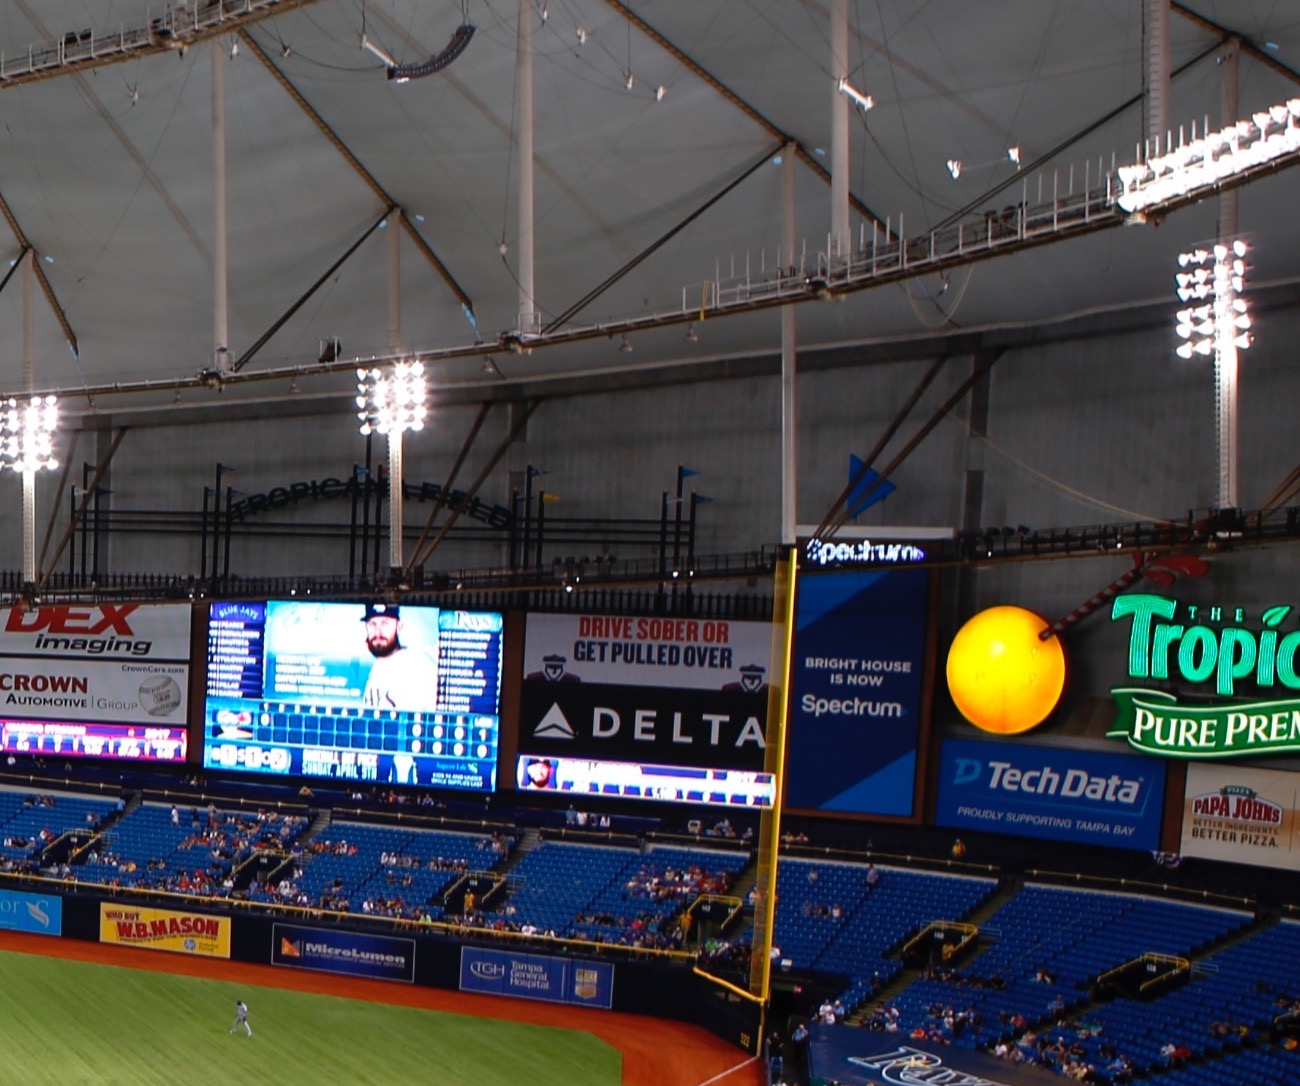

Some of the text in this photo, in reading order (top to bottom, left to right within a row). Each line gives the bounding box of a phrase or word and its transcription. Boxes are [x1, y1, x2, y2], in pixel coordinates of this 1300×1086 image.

[1188, 606, 1243, 623] THE
[578, 616, 729, 644] DRIVE SOBER OR
[35, 634, 152, 655] imaging
[573, 640, 733, 669] GET PULLED OVER
[121, 664, 185, 675] CrownCars.com
[805, 657, 911, 674] BRIGHT HOUSE
[830, 673, 884, 686] IS NOW
[6, 694, 138, 711] AUTOMOTIVE GROUP
[801, 694, 902, 718] Spectrum
[592, 707, 767, 749] DELTA
[1133, 708, 1216, 748] PURE
[988, 761, 1140, 805] Tech Data
[957, 806, 1135, 837] PROUDLY SUPPORTING TAMPA BAY
[1192, 829, 1279, 848] BETTER PIZZA.
[511, 960, 543, 974] Tampa
[511, 969, 547, 982] General
[510, 976, 550, 990] Hospital
